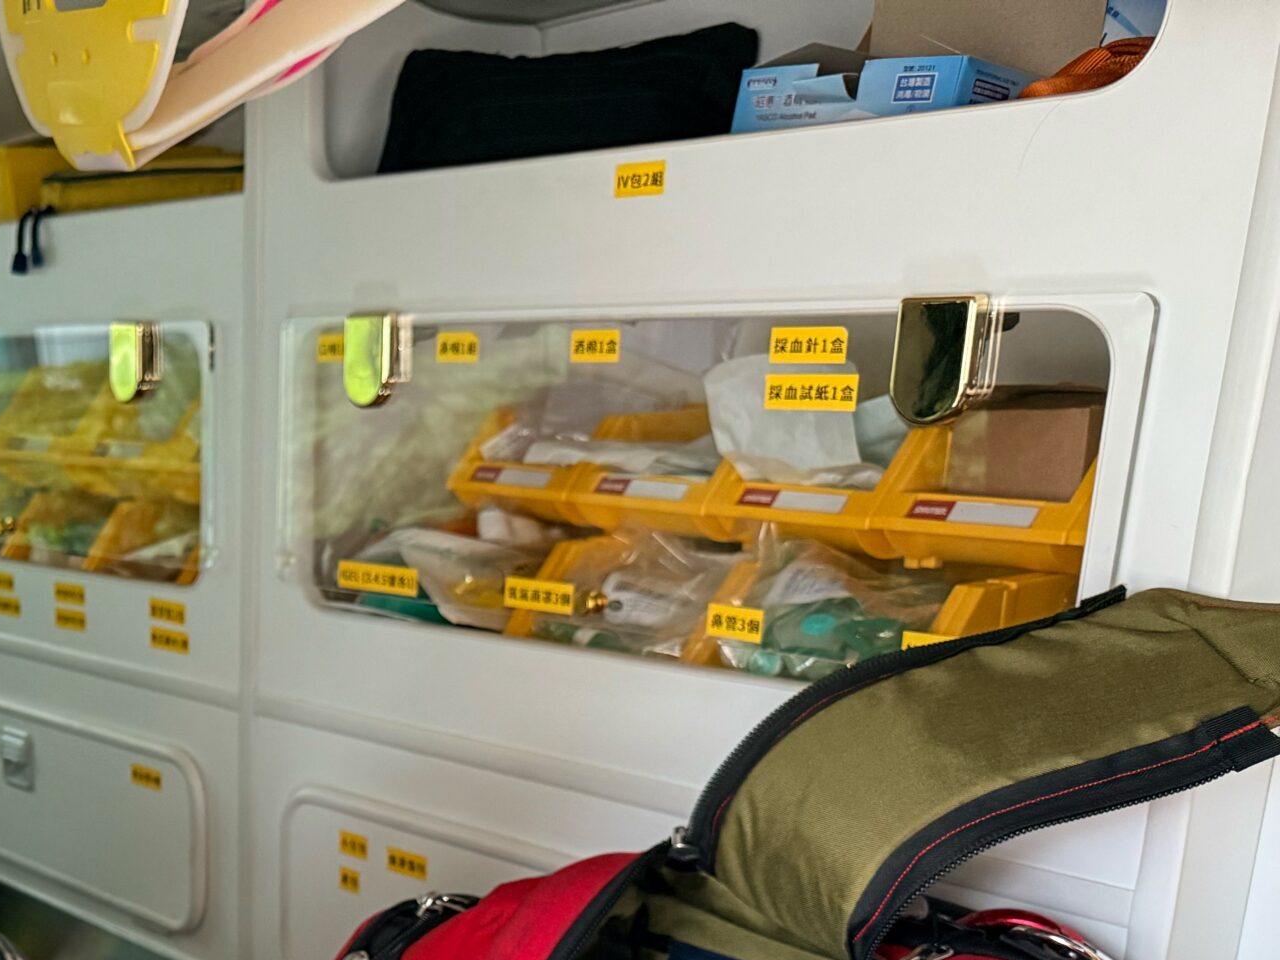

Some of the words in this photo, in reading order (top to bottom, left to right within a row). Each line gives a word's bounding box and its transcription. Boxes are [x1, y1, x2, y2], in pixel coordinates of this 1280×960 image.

[774, 337, 845, 354] 採血針1盒
[768, 384, 854, 401] 採血試紙1盒
